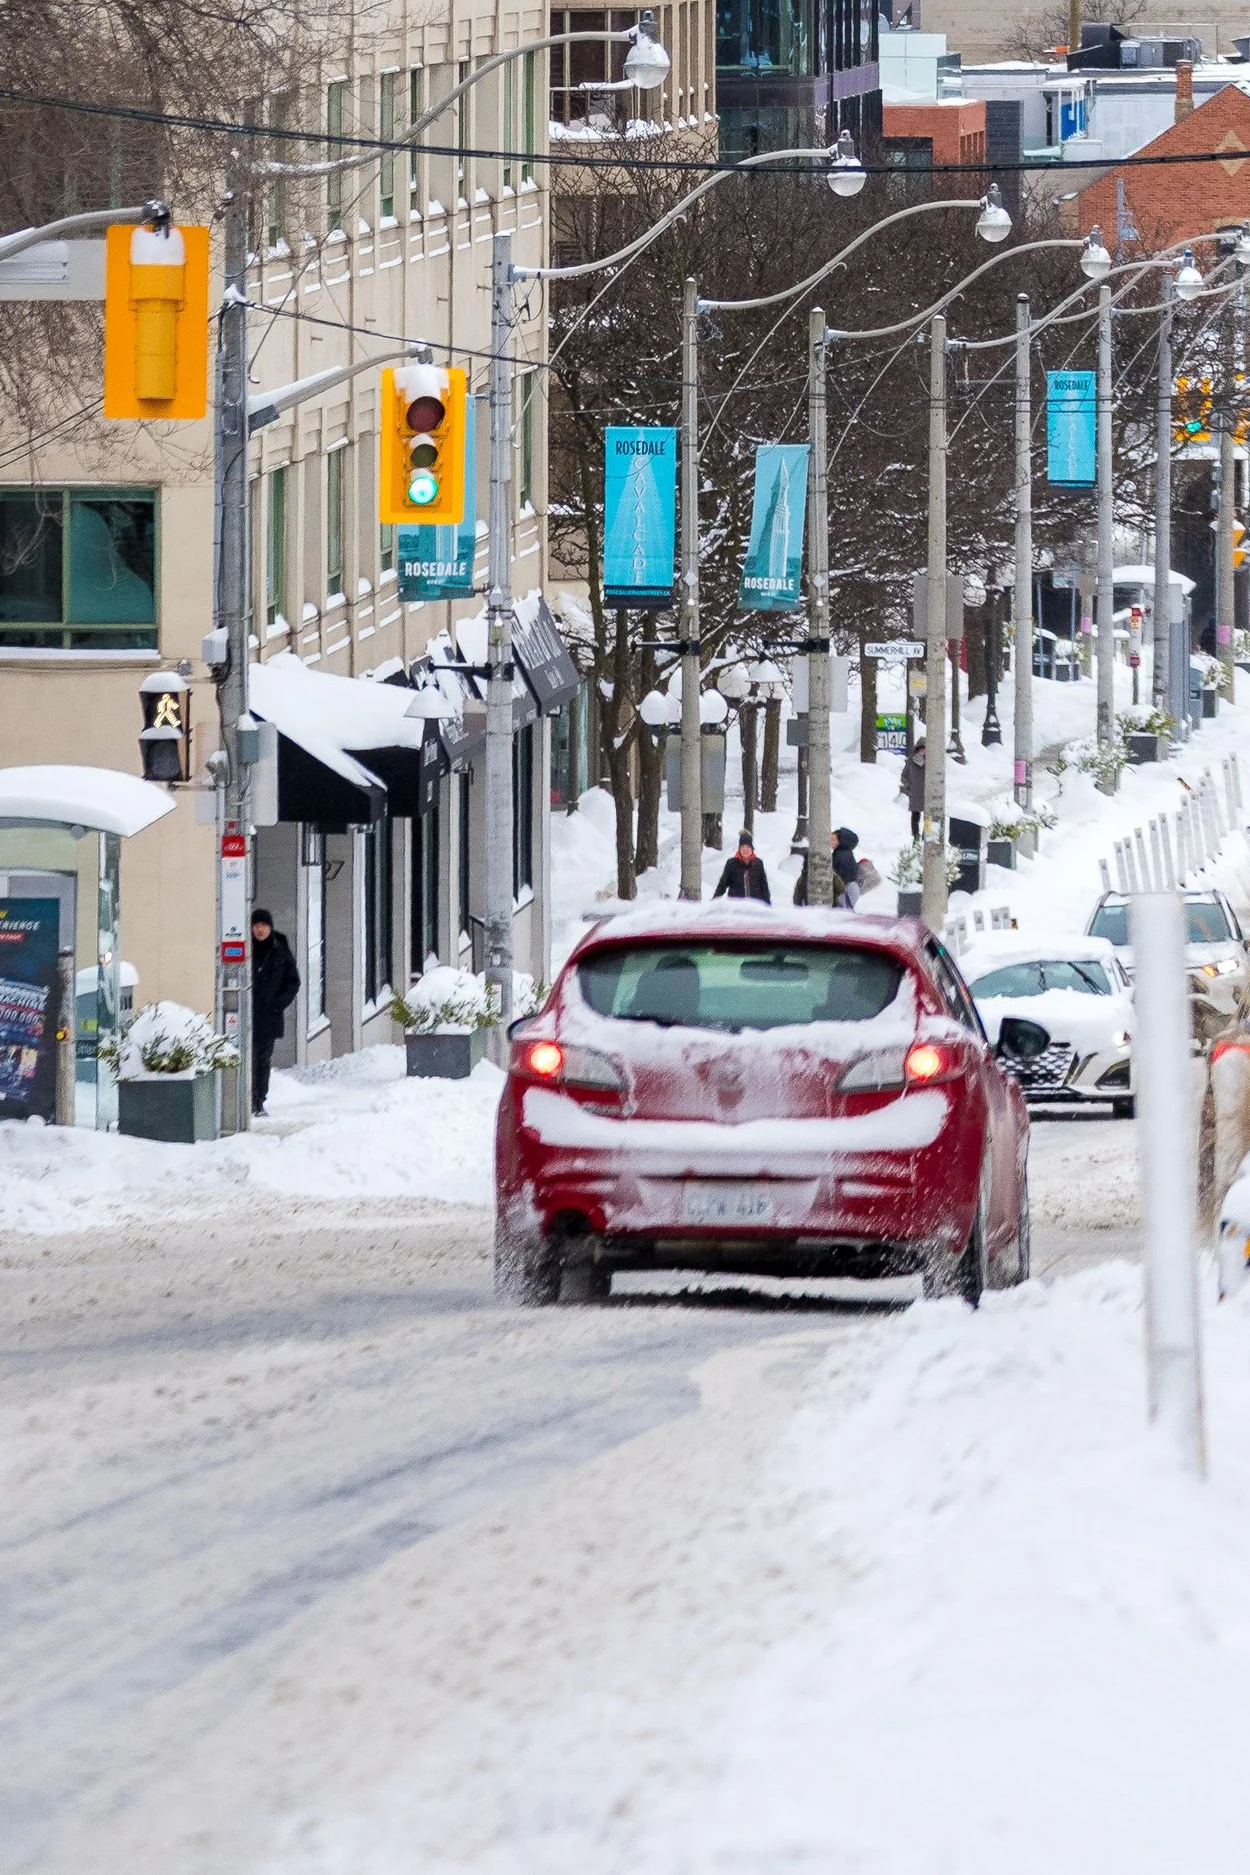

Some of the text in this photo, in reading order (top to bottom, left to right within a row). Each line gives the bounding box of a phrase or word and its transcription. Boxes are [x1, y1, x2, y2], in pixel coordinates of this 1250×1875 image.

[1054, 379, 1089, 390] ROSEDALE
[615, 440, 666, 456] ROSEDALE
[404, 561, 467, 577] ROSEDALE
[744, 577, 795, 591] ROSEDALE
[867, 645, 910, 656] SUMMERHILL
